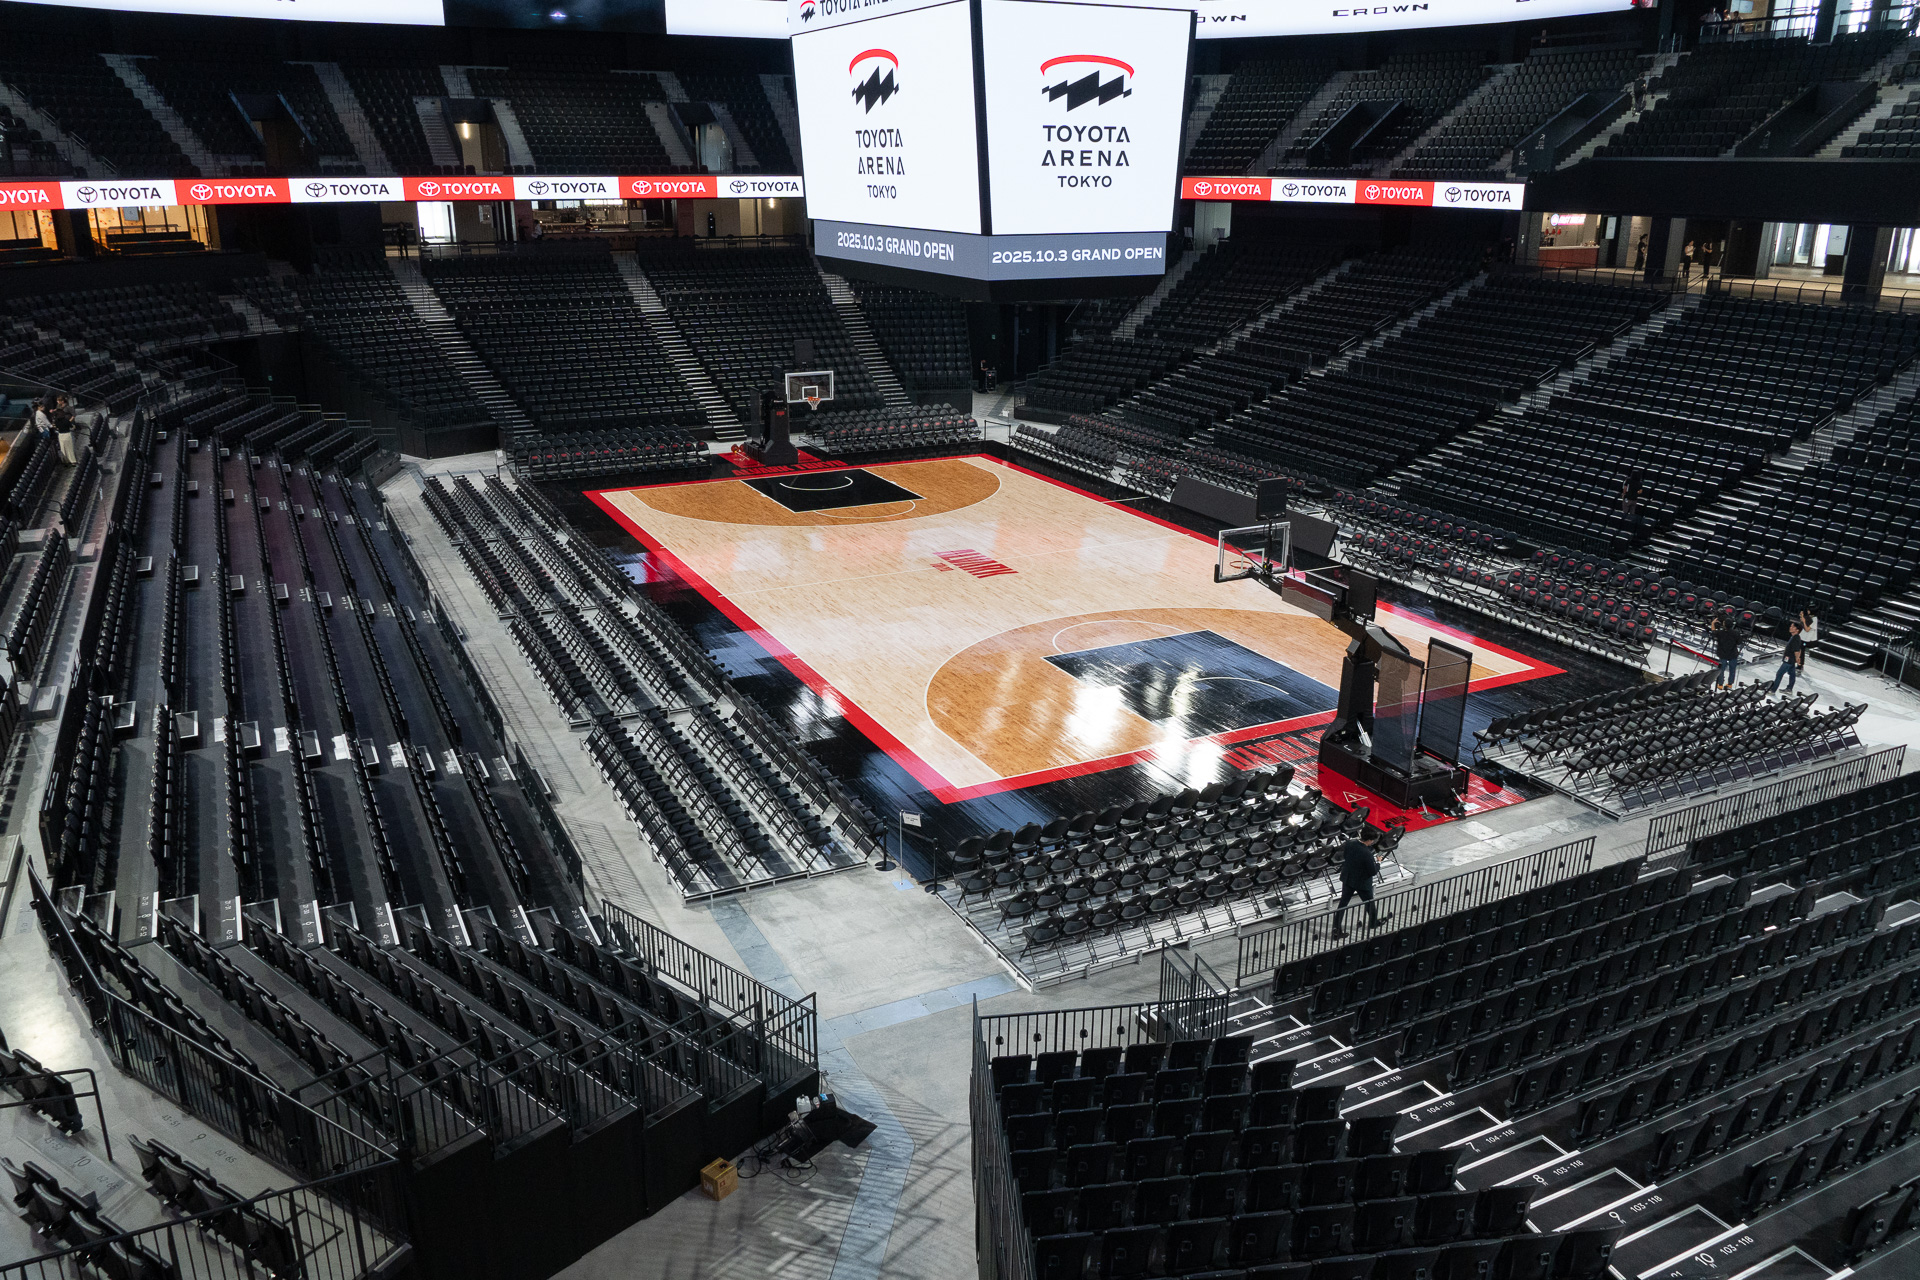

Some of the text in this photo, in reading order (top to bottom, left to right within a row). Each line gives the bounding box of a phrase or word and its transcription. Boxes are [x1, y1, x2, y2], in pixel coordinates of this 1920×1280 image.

[1332, 3, 1429, 16] CROWN
[1197, 14, 1246, 23] OWN
[855, 128, 903, 149] TOYOTA
[1042, 125, 1131, 143] TOYOTA
[1041, 150, 1130, 167] ARENA
[858, 156, 905, 175] ARENA
[551, 182, 607, 194] TOYOTA
[653, 181, 706, 193] TOYOTA
[750, 181, 799, 192] TOYOTA
[1057, 175, 1112, 188] TOKYO
[100, 187, 161, 200] TOYOTA
[214, 185, 276, 198] TOYOTA
[330, 184, 390, 196] TOYOTA
[442, 182, 502, 195] TOYOTA
[867, 184, 897, 199] TOKYO
[1214, 183, 1261, 195] TOYOTA
[1301, 185, 1347, 197] TOYOTA
[1381, 187, 1423, 200] TOYOTA
[0, 189, 50, 204] OYOTA
[1463, 189, 1511, 203] TOYOTA
[837, 232, 954, 261] 2025.10.3 GRAND OPEN
[992, 247, 1163, 264] 2025.10.3 GRAND OPEN
